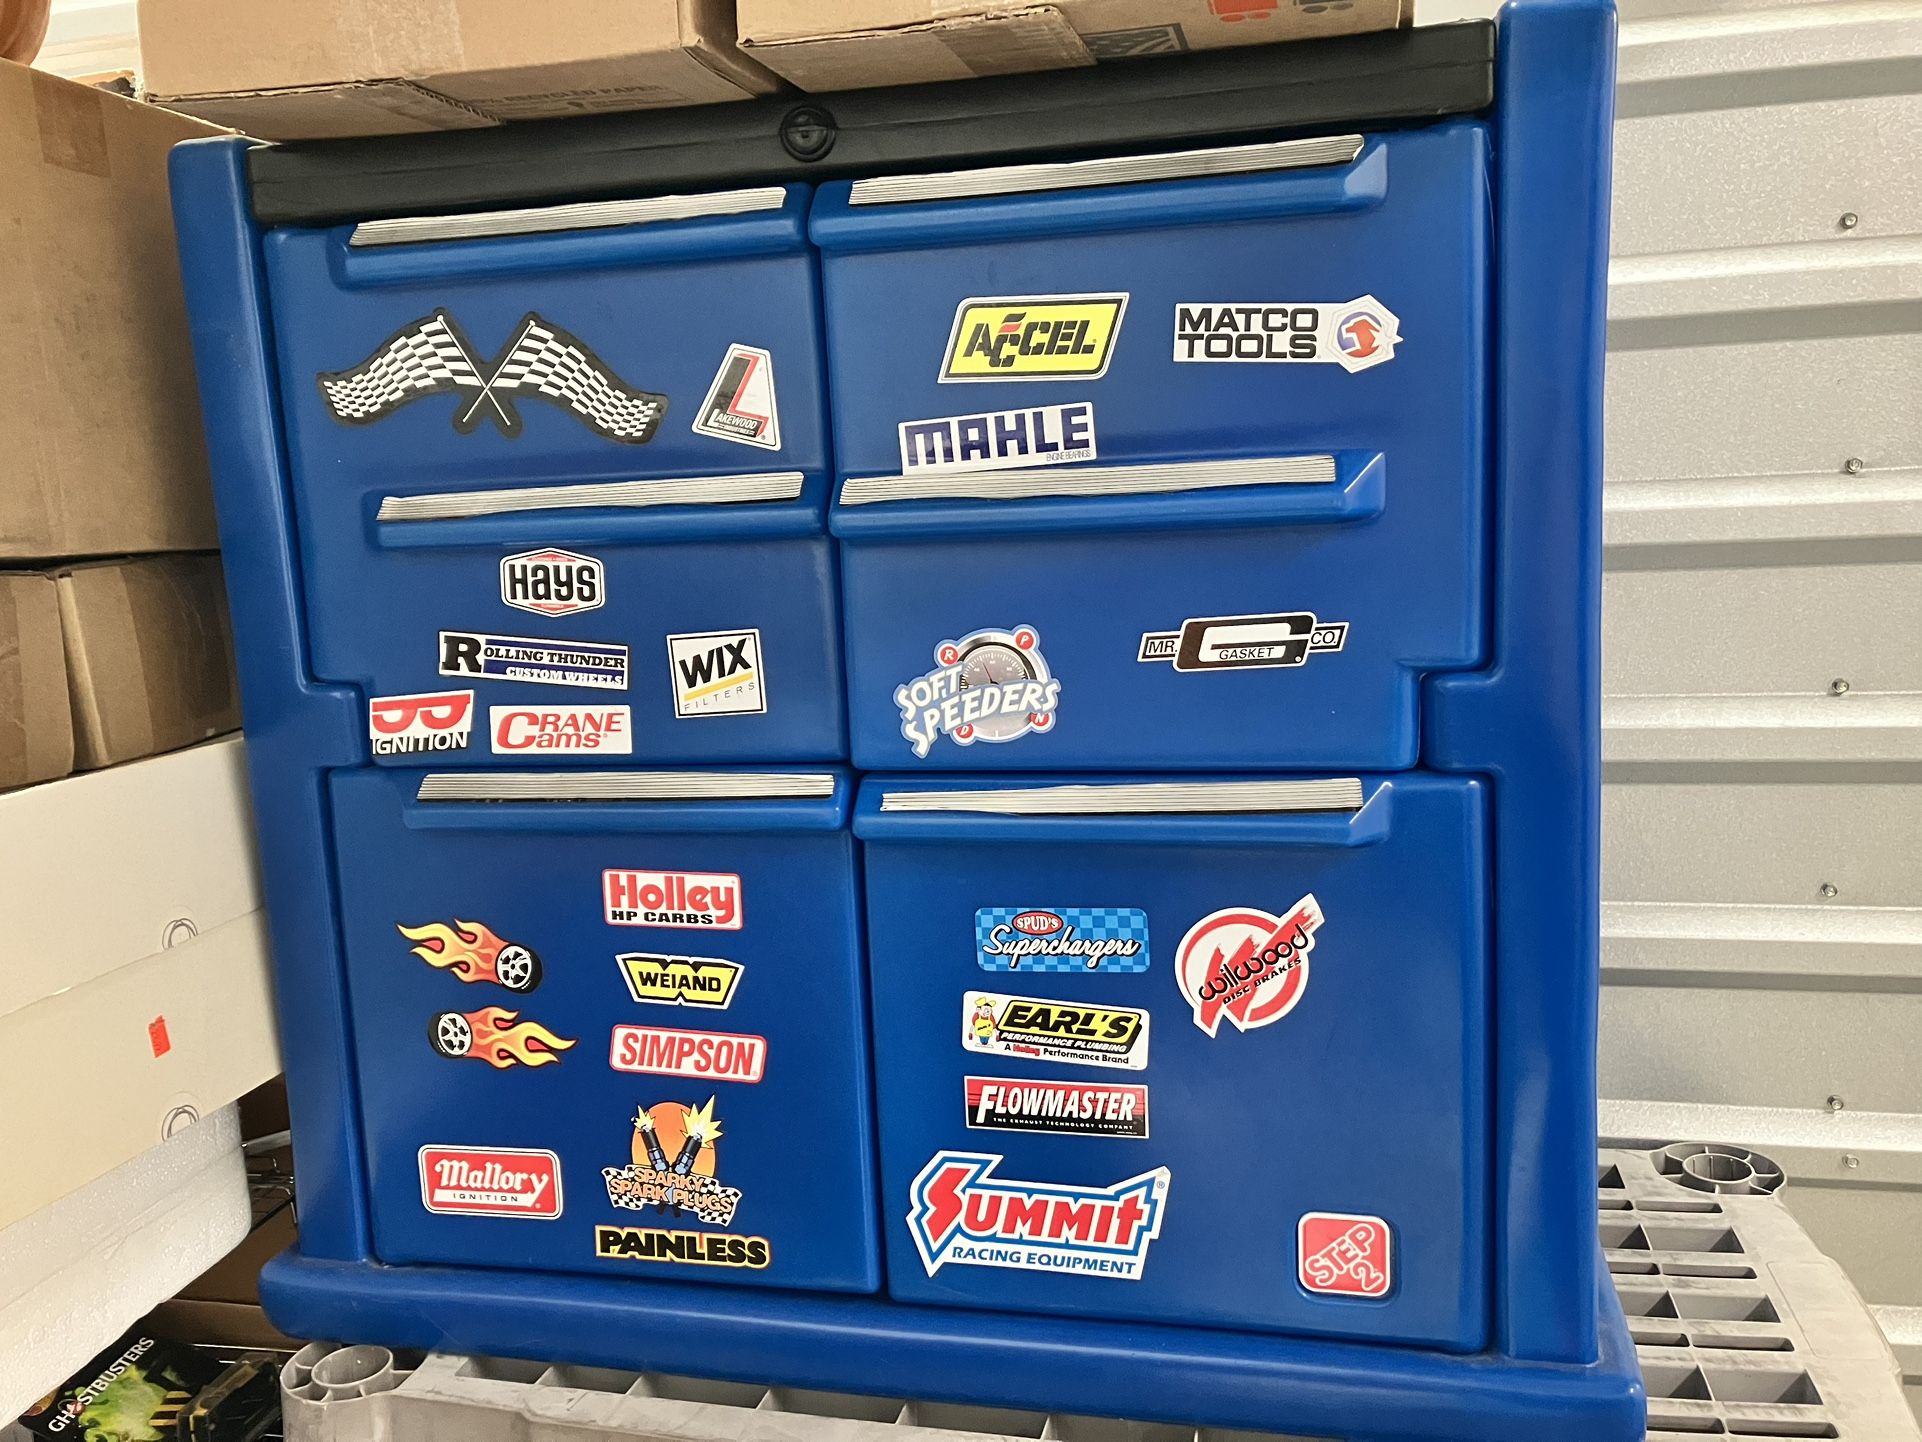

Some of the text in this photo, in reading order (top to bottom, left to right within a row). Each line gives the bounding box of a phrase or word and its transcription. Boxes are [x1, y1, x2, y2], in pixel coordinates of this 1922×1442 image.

[1179, 307, 1319, 333] MATCO
[962, 311, 1096, 368] ACCEL
[1178, 333, 1317, 359] TOOLS
[706, 408, 758, 430] LAKEWOOD
[904, 406, 1090, 466] MAHLE
[441, 635, 625, 674] ROLLING THUNDER
[943, 649, 955, 661] R
[1019, 634, 1030, 646] P
[1148, 640, 1178, 654] MR.
[1218, 647, 1275, 660] GASKET
[1310, 631, 1337, 645] CO.
[505, 666, 624, 686] CUSTOM WHEELS
[678, 637, 752, 689] WIX
[684, 682, 755, 712] FILTERS
[897, 664, 963, 721] SOFT
[497, 711, 625, 750] CRANE
[905, 682, 1058, 755] SPEEDERS
[372, 731, 468, 755] IGNITION
[608, 873, 736, 924] Holley
[611, 910, 714, 925] HP CARBS
[1016, 915, 1059, 931] SPUD'S
[982, 923, 1139, 968] Superchargers
[1198, 923, 1309, 1001] wilwood
[638, 971, 721, 992] WEIAND
[1223, 956, 1302, 1005] DISC BRAKES
[1003, 1004, 1135, 1039] EARL'S
[619, 1032, 756, 1076] SIMPSON
[1000, 1032, 1128, 1053] PERFORMANCE PLUMBING
[1004, 1043, 1012, 1051] A
[1043, 1048, 1100, 1061] Performance
[1101, 1054, 1129, 1065] Brand
[975, 1084, 1137, 1124] FLOWMASTER
[434, 1158, 550, 1195] Mallory
[634, 1167, 705, 1192] SPARKY
[453, 1193, 519, 1202] IGNITION
[609, 1178, 733, 1213] SPARK PLUGS
[599, 1229, 767, 1266] PAINLESS
[952, 1246, 1137, 1275] RACING EQUIPMENT
[1304, 1222, 1376, 1287] STEP
[1349, 1258, 1385, 1292] 2
